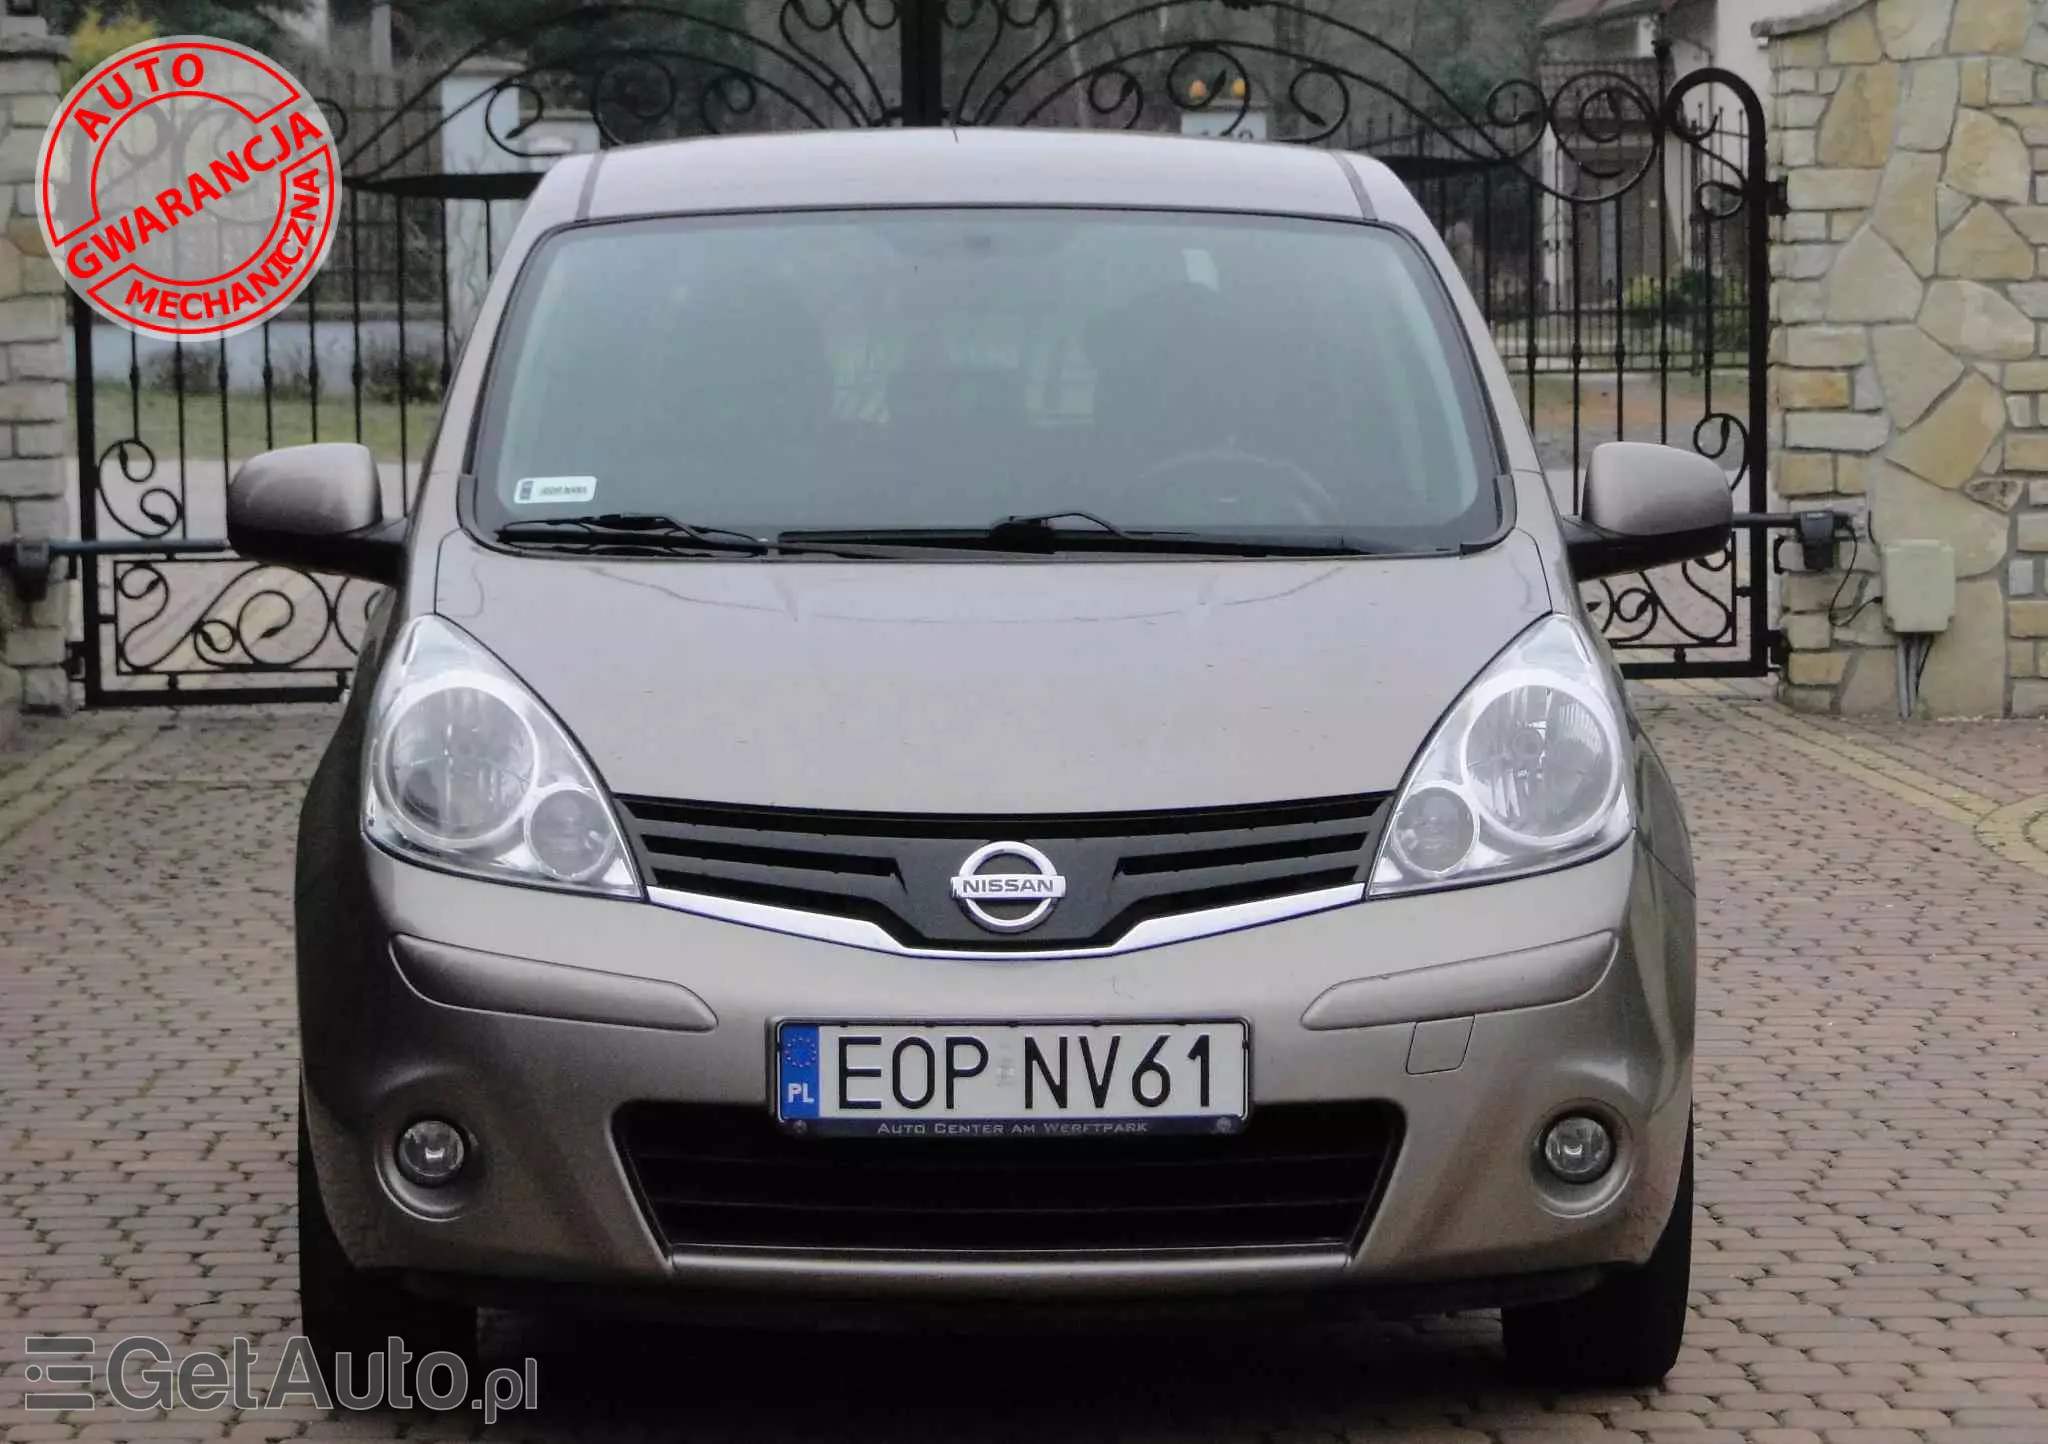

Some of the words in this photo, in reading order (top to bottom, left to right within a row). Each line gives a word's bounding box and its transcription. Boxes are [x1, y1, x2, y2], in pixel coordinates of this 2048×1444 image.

[963, 879, 1053, 893] NISSAN
[838, 1036, 989, 1110] EOP
[1025, 1034, 1210, 1109] NV61
[788, 1083, 814, 1103] PL
